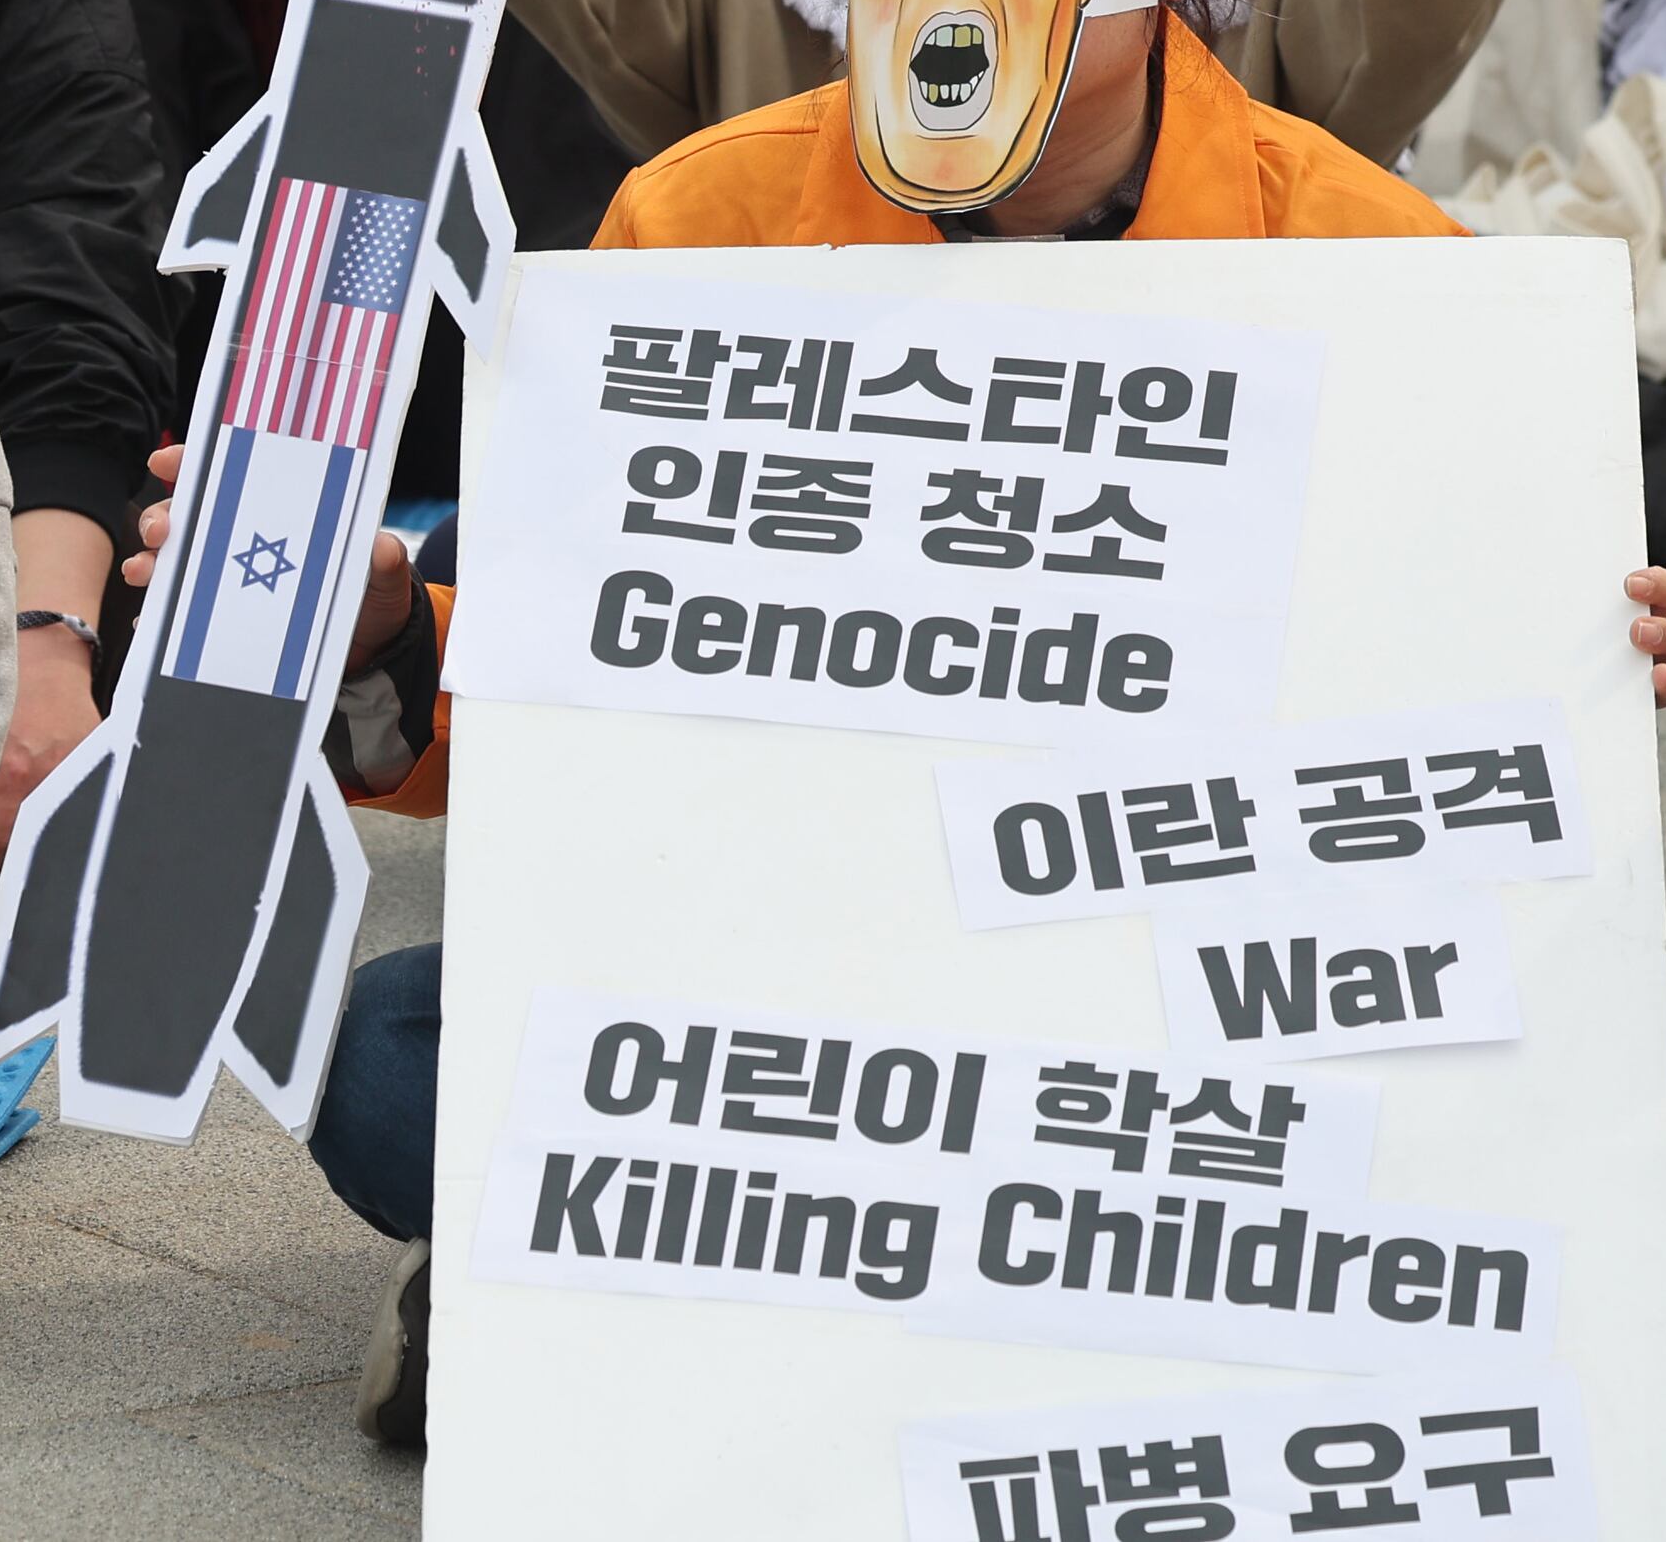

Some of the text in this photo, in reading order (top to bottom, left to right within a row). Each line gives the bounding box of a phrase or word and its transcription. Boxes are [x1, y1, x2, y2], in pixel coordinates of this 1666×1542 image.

[600, 325, 1237, 466] 팔레스타인
[622, 446, 1167, 580] 인종 청소
[591, 570, 1173, 713] Genocide
[994, 744, 1562, 895] 이란 공격
[1197, 937, 1458, 1040] War
[584, 1022, 1306, 1187] 어린이 학살
[530, 1153, 1528, 1332] Killing Children
[958, 1407, 1554, 1542] 파병 요구
